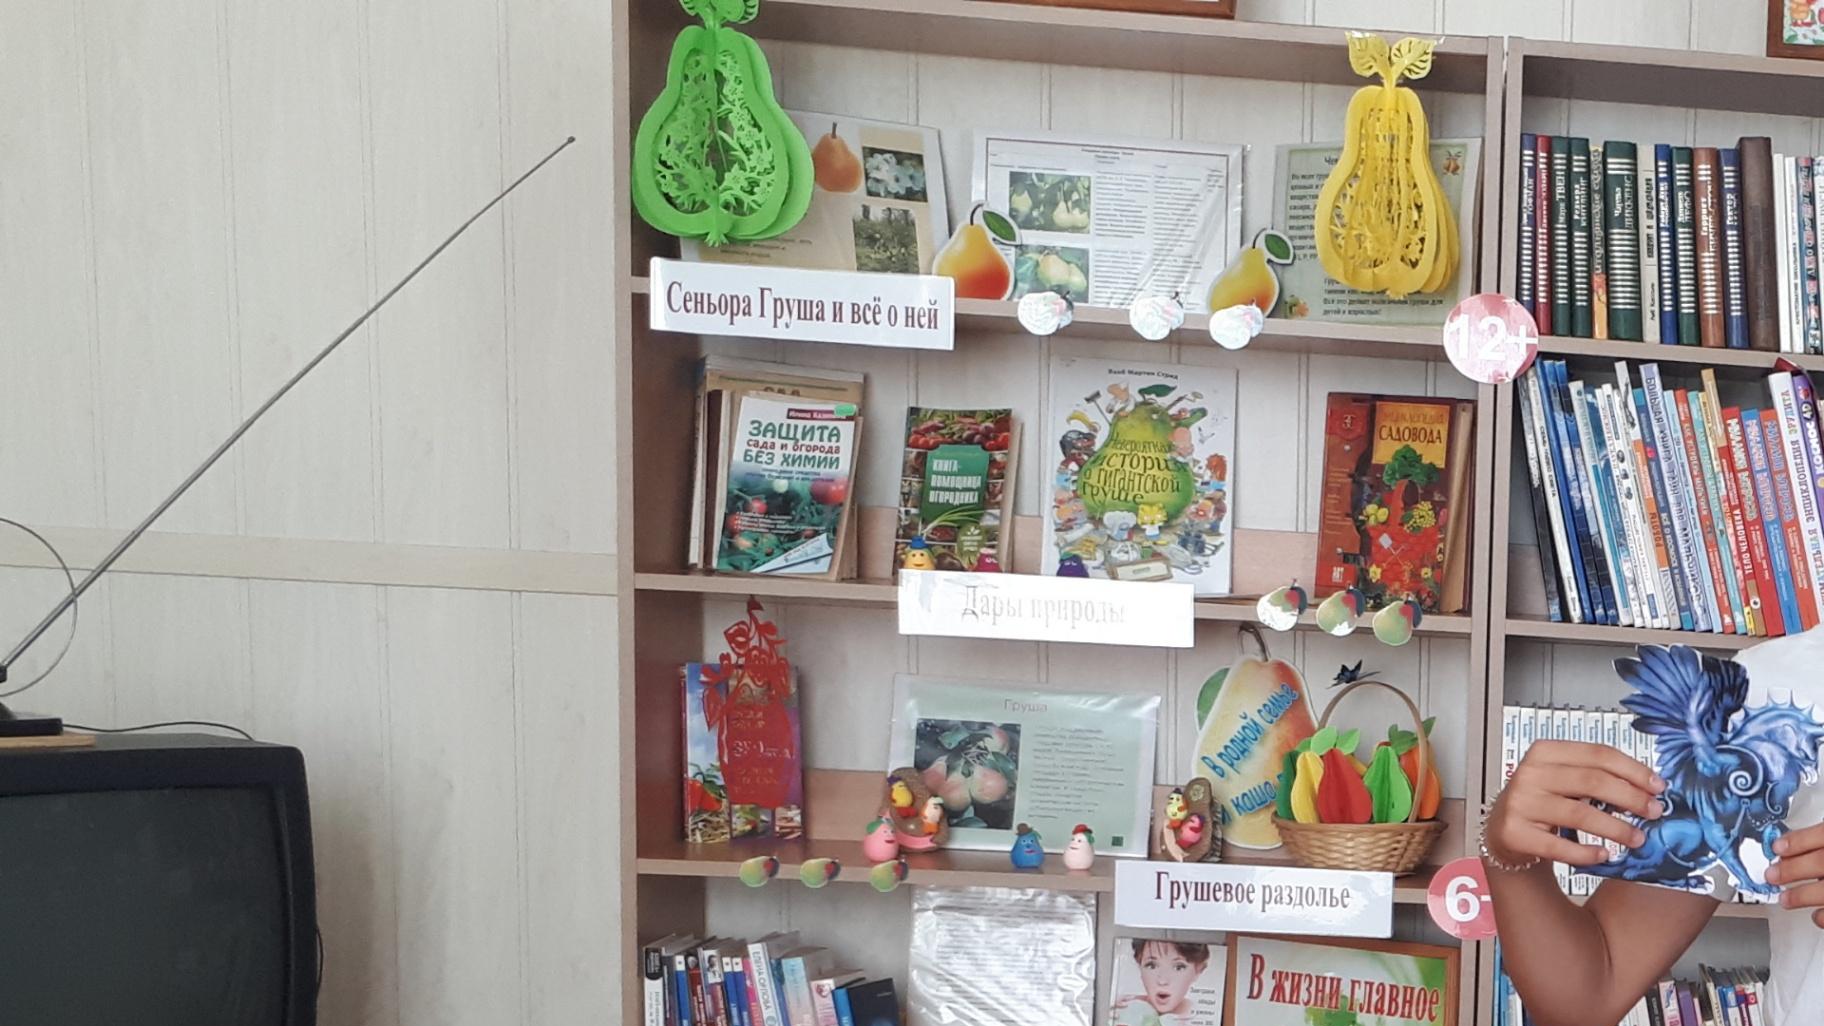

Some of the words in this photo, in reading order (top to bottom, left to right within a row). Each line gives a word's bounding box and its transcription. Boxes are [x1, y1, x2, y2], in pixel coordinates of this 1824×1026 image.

[666, 281, 752, 326] Сеньора
[759, 286, 826, 329] Груша
[832, 301, 843, 323] и
[851, 296, 882, 326] всё
[887, 305, 898, 327] о
[904, 299, 939, 330] ней
[1450, 313, 1538, 361] 12+
[1645, 377, 1665, 424] БОЛЬШАЯ
[1781, 390, 1798, 435] ЭРУДИТА
[746, 438, 776, 452] сада
[780, 441, 788, 452] и
[792, 440, 841, 455] огорода
[748, 419, 842, 444] ЗАЩИТА
[1378, 425, 1443, 445] САДОВОДА
[1659, 427, 1673, 468] КНИГА
[742, 449, 774, 465] БЕЗ
[780, 451, 841, 470] ХИМИИ
[929, 489, 980, 505] ОГОРОДНИКА
[930, 474, 982, 490] ПОМОЩНИЦА
[1082, 482, 1145, 505] груше
[1096, 467, 1182, 495] гигантской
[1665, 468, 1678, 495] ТАЙН
[1790, 439, 1815, 522] ЭНЦИКЛОПЕДИЯ
[1649, 512, 1664, 548] РОБОТЫ
[1733, 509, 1751, 551] ЧЕЛОВЕКА
[1742, 552, 1754, 575] ТЕЛО
[960, 585, 1023, 627] Дары
[1031, 595, 1126, 628] природы
[1003, 698, 1048, 714] Груша
[1200, 755, 1225, 779] В
[1217, 712, 1263, 772] родной
[1256, 682, 1300, 730] семье
[1231, 779, 1278, 819] каша
[1155, 871, 1256, 911] Грушевое
[1261, 882, 1351, 913] раздолье
[1444, 875, 1491, 922] 6
[1247, 953, 1265, 1001] В
[1268, 968, 1342, 1010] жизни
[1348, 978, 1441, 1023] главное
